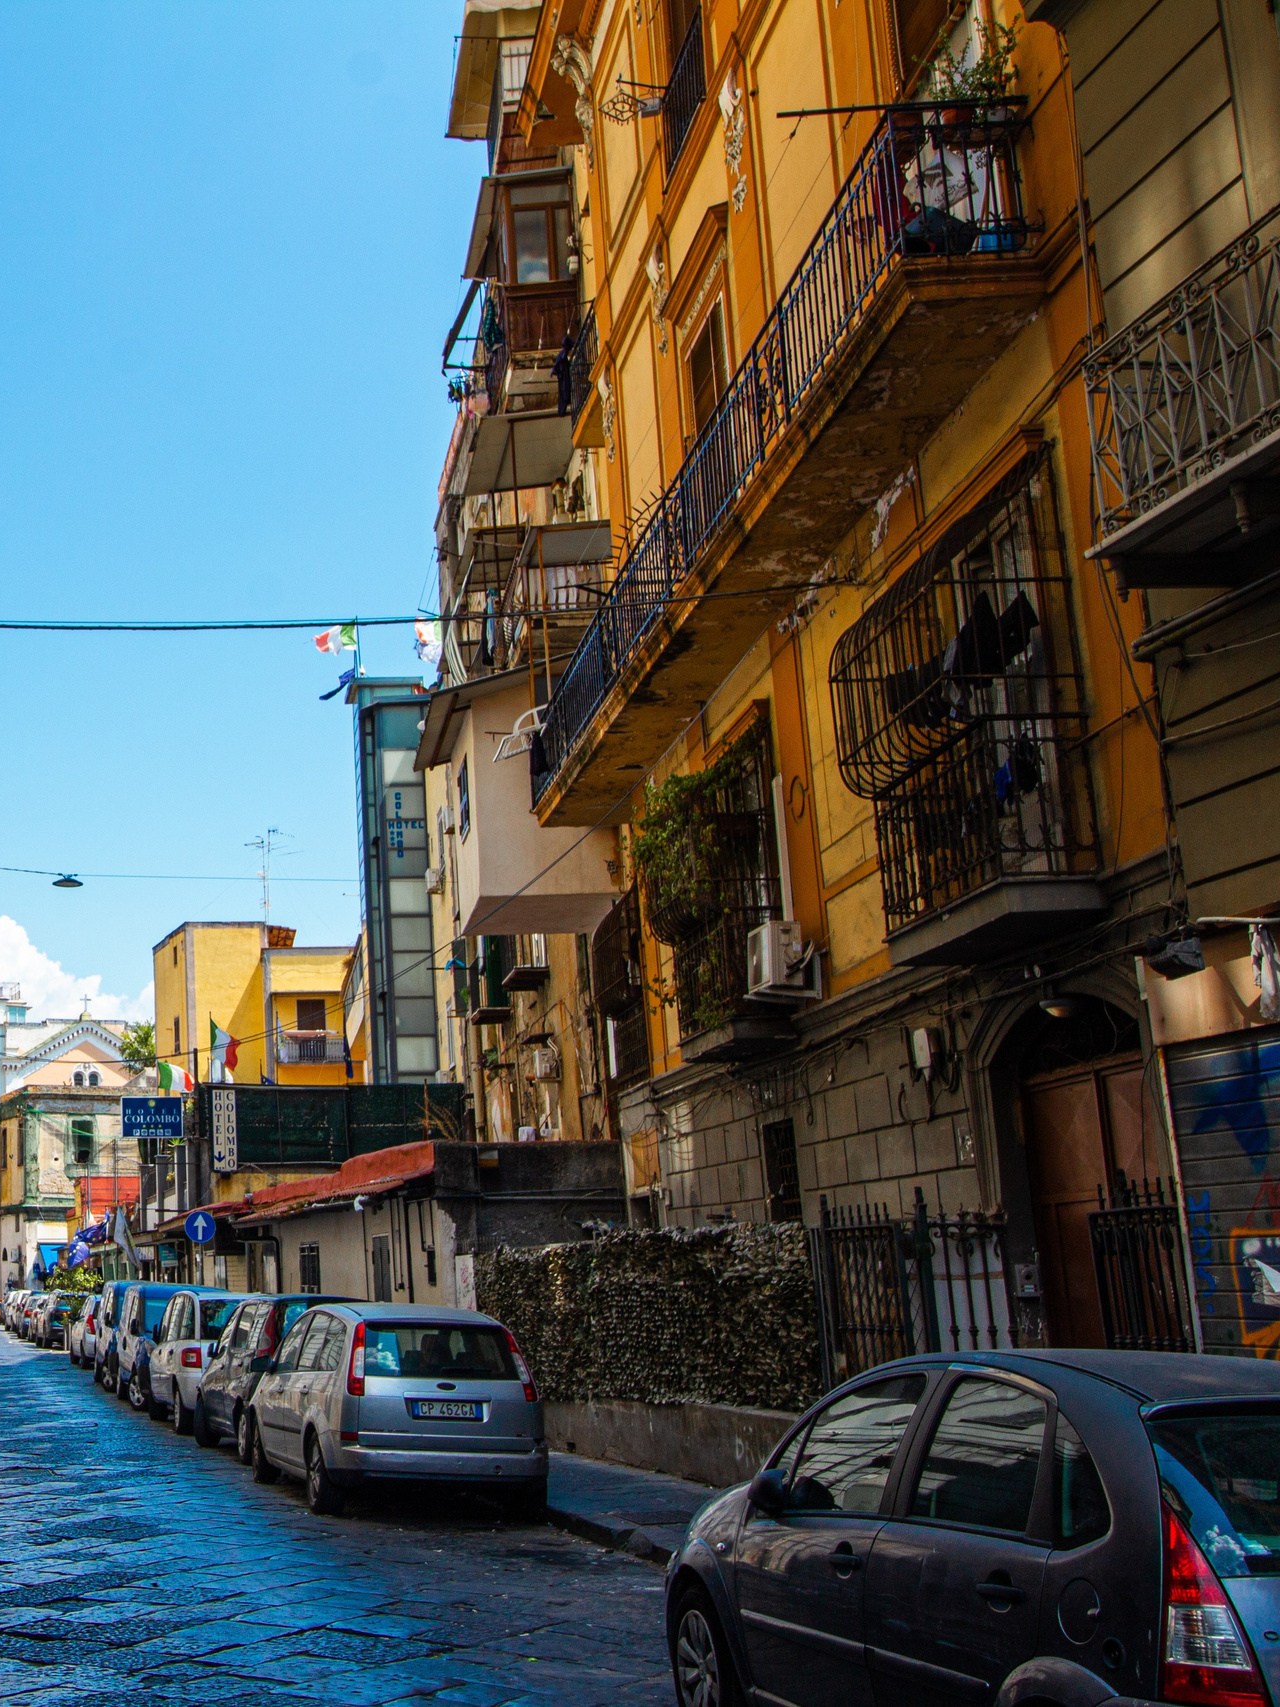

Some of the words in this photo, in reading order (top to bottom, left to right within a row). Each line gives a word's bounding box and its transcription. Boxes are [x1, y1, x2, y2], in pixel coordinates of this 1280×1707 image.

[388, 821, 424, 829] HOTEL
[395, 792, 404, 858] COLOMBO
[124, 1114, 180, 1124] COLOMBO
[214, 1091, 222, 1146] HOTEL
[226, 1091, 236, 1168] COLOMBO
[420, 1402, 434, 1415] CP
[439, 1403, 476, 1417] 462GA
